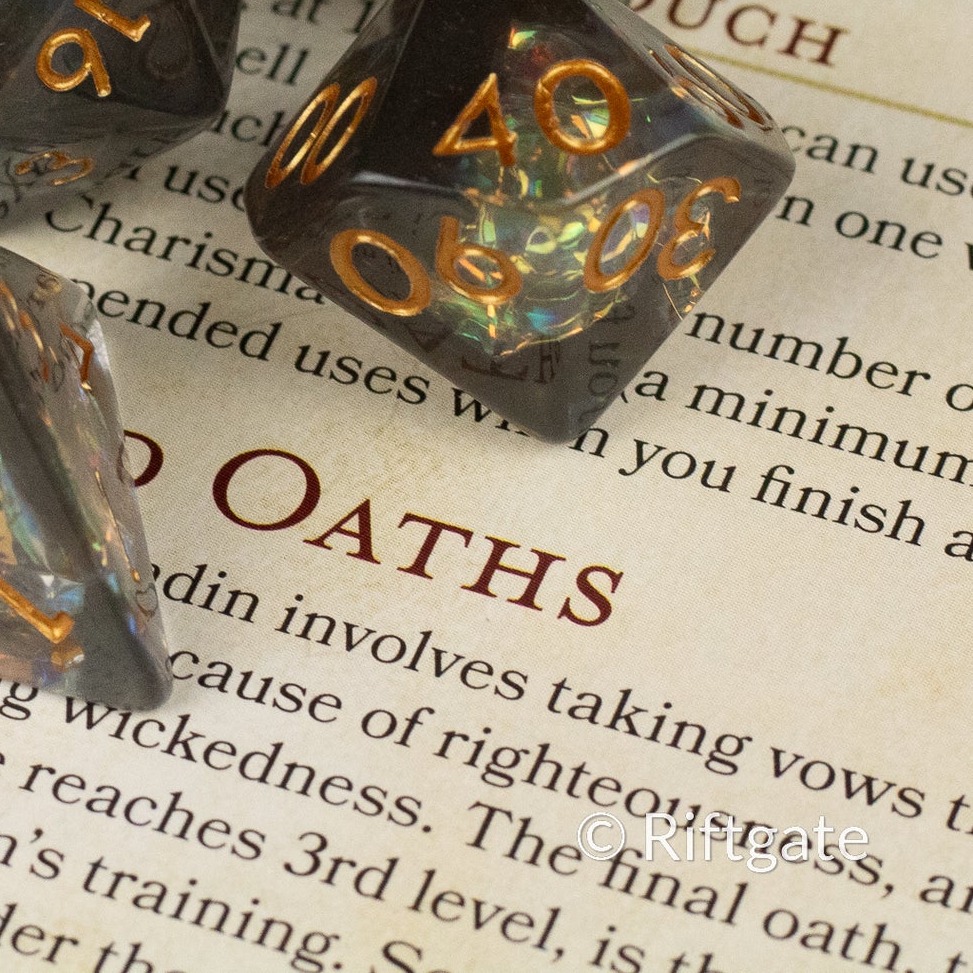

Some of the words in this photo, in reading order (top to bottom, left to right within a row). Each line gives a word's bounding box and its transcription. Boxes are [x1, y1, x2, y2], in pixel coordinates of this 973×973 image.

[233, 41, 311, 87] ell
[432, 57, 631, 168] 40
[834, 210, 944, 259] one
[686, 311, 933, 397] number
[293, 343, 432, 406] uses
[617, 438, 737, 493] you
[751, 463, 926, 547] finish
[211, 447, 624, 628] OATHS
[166, 649, 343, 725] cause
[360, 706, 436, 748] of
[275, 593, 529, 701] involves
[546, 678, 753, 776] taking
[771, 747, 926, 819] vows
[65, 694, 432, 834] wickedness.
[20, 762, 266, 861] reaches
[283, 830, 399, 901] 3rd
[409, 868, 566, 960] level,
[590, 925, 643, 973] is
[82, 858, 344, 973] training.
[468, 800, 584, 875] The
[599, 846, 750, 927] final
